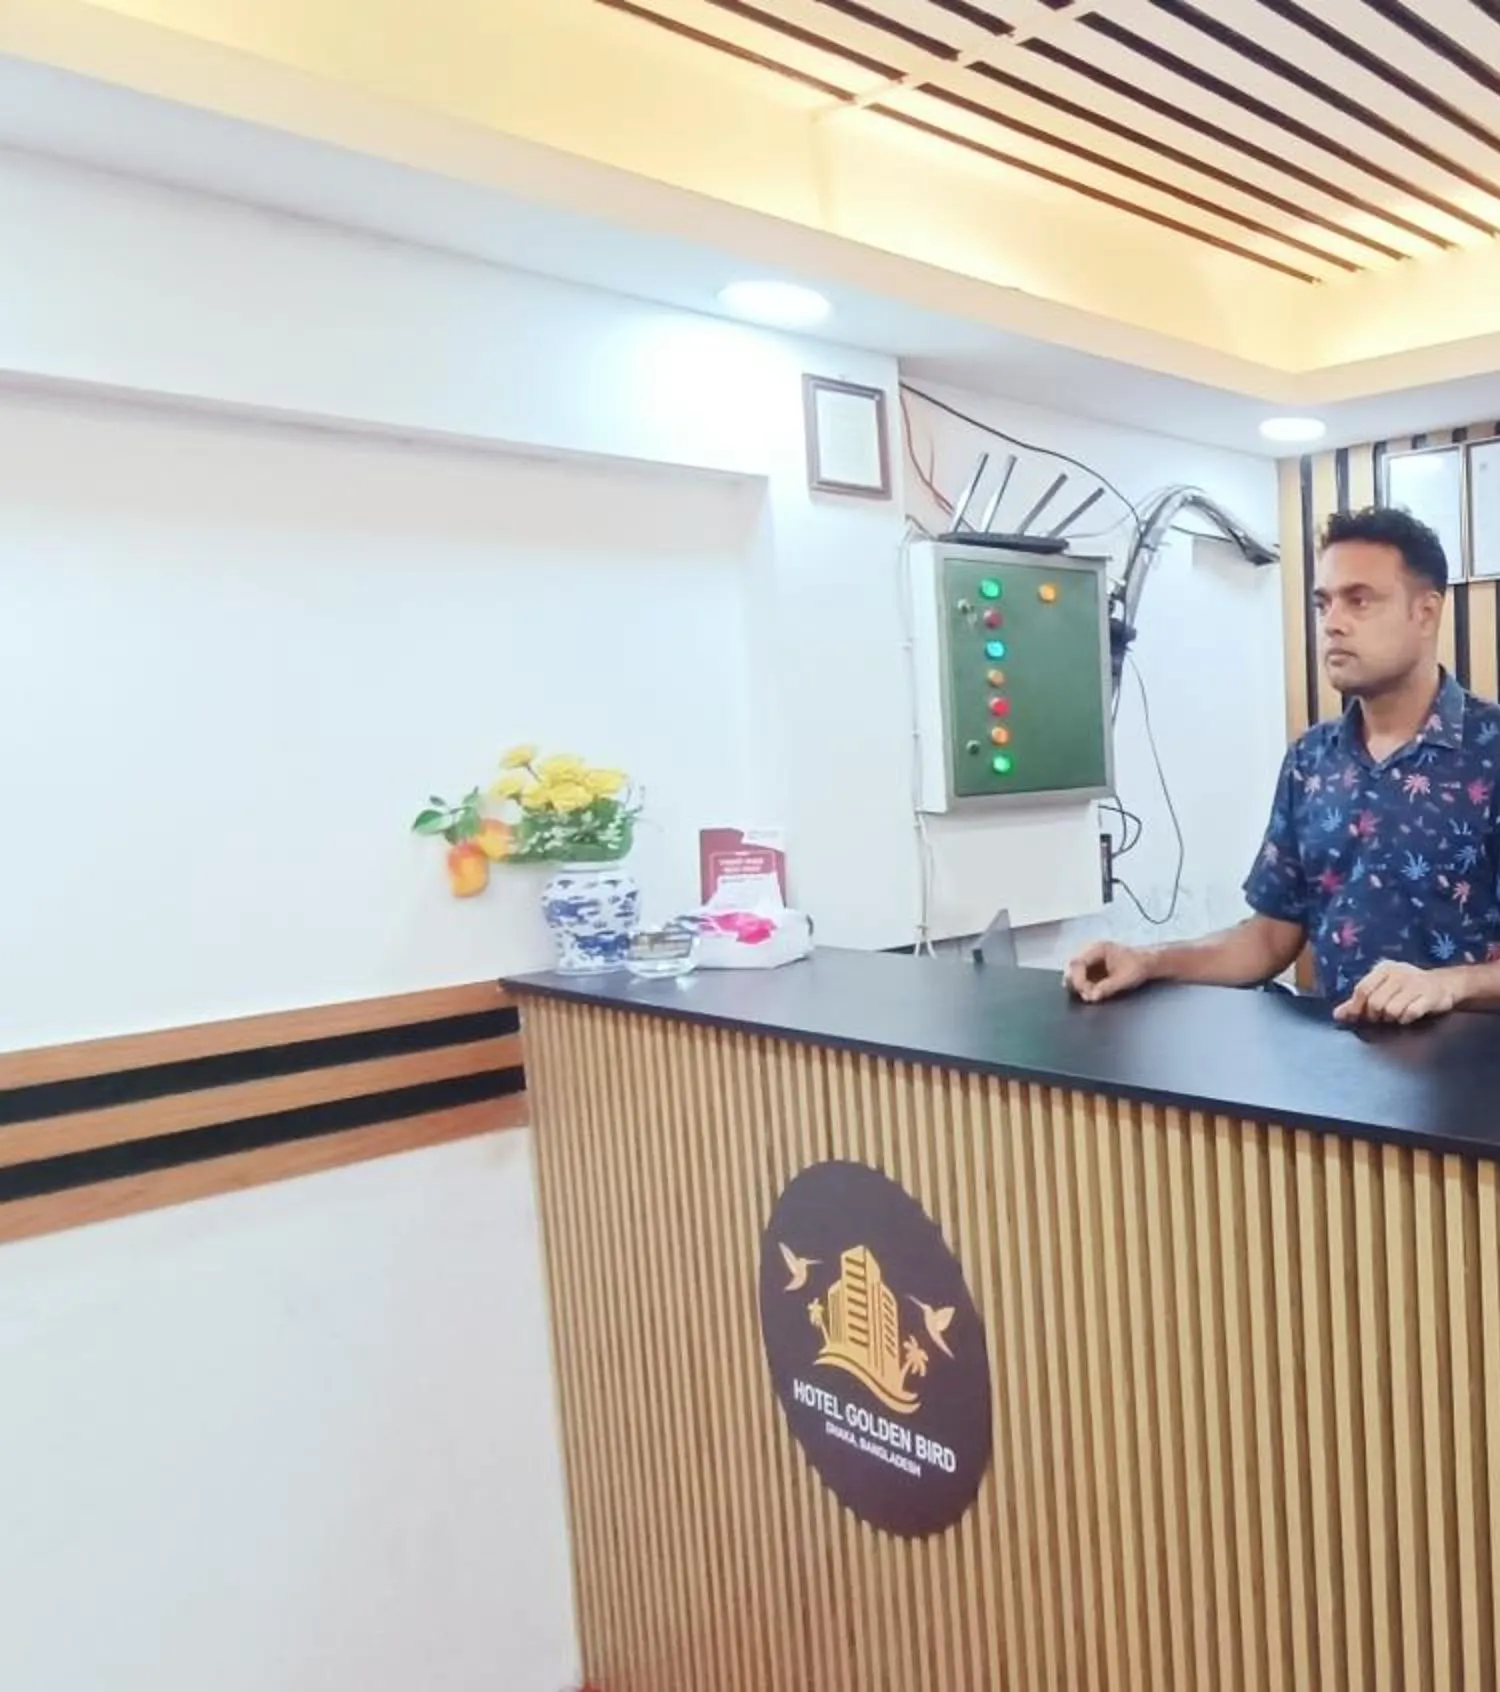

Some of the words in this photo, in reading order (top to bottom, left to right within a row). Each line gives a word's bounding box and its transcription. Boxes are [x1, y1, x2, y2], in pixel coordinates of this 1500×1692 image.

[793, 1378, 844, 1421] HOTEL
[845, 1403, 911, 1453] GOLDEN
[915, 1434, 957, 1473] BIRD
[859, 1437, 921, 1478] BANGLADESH
